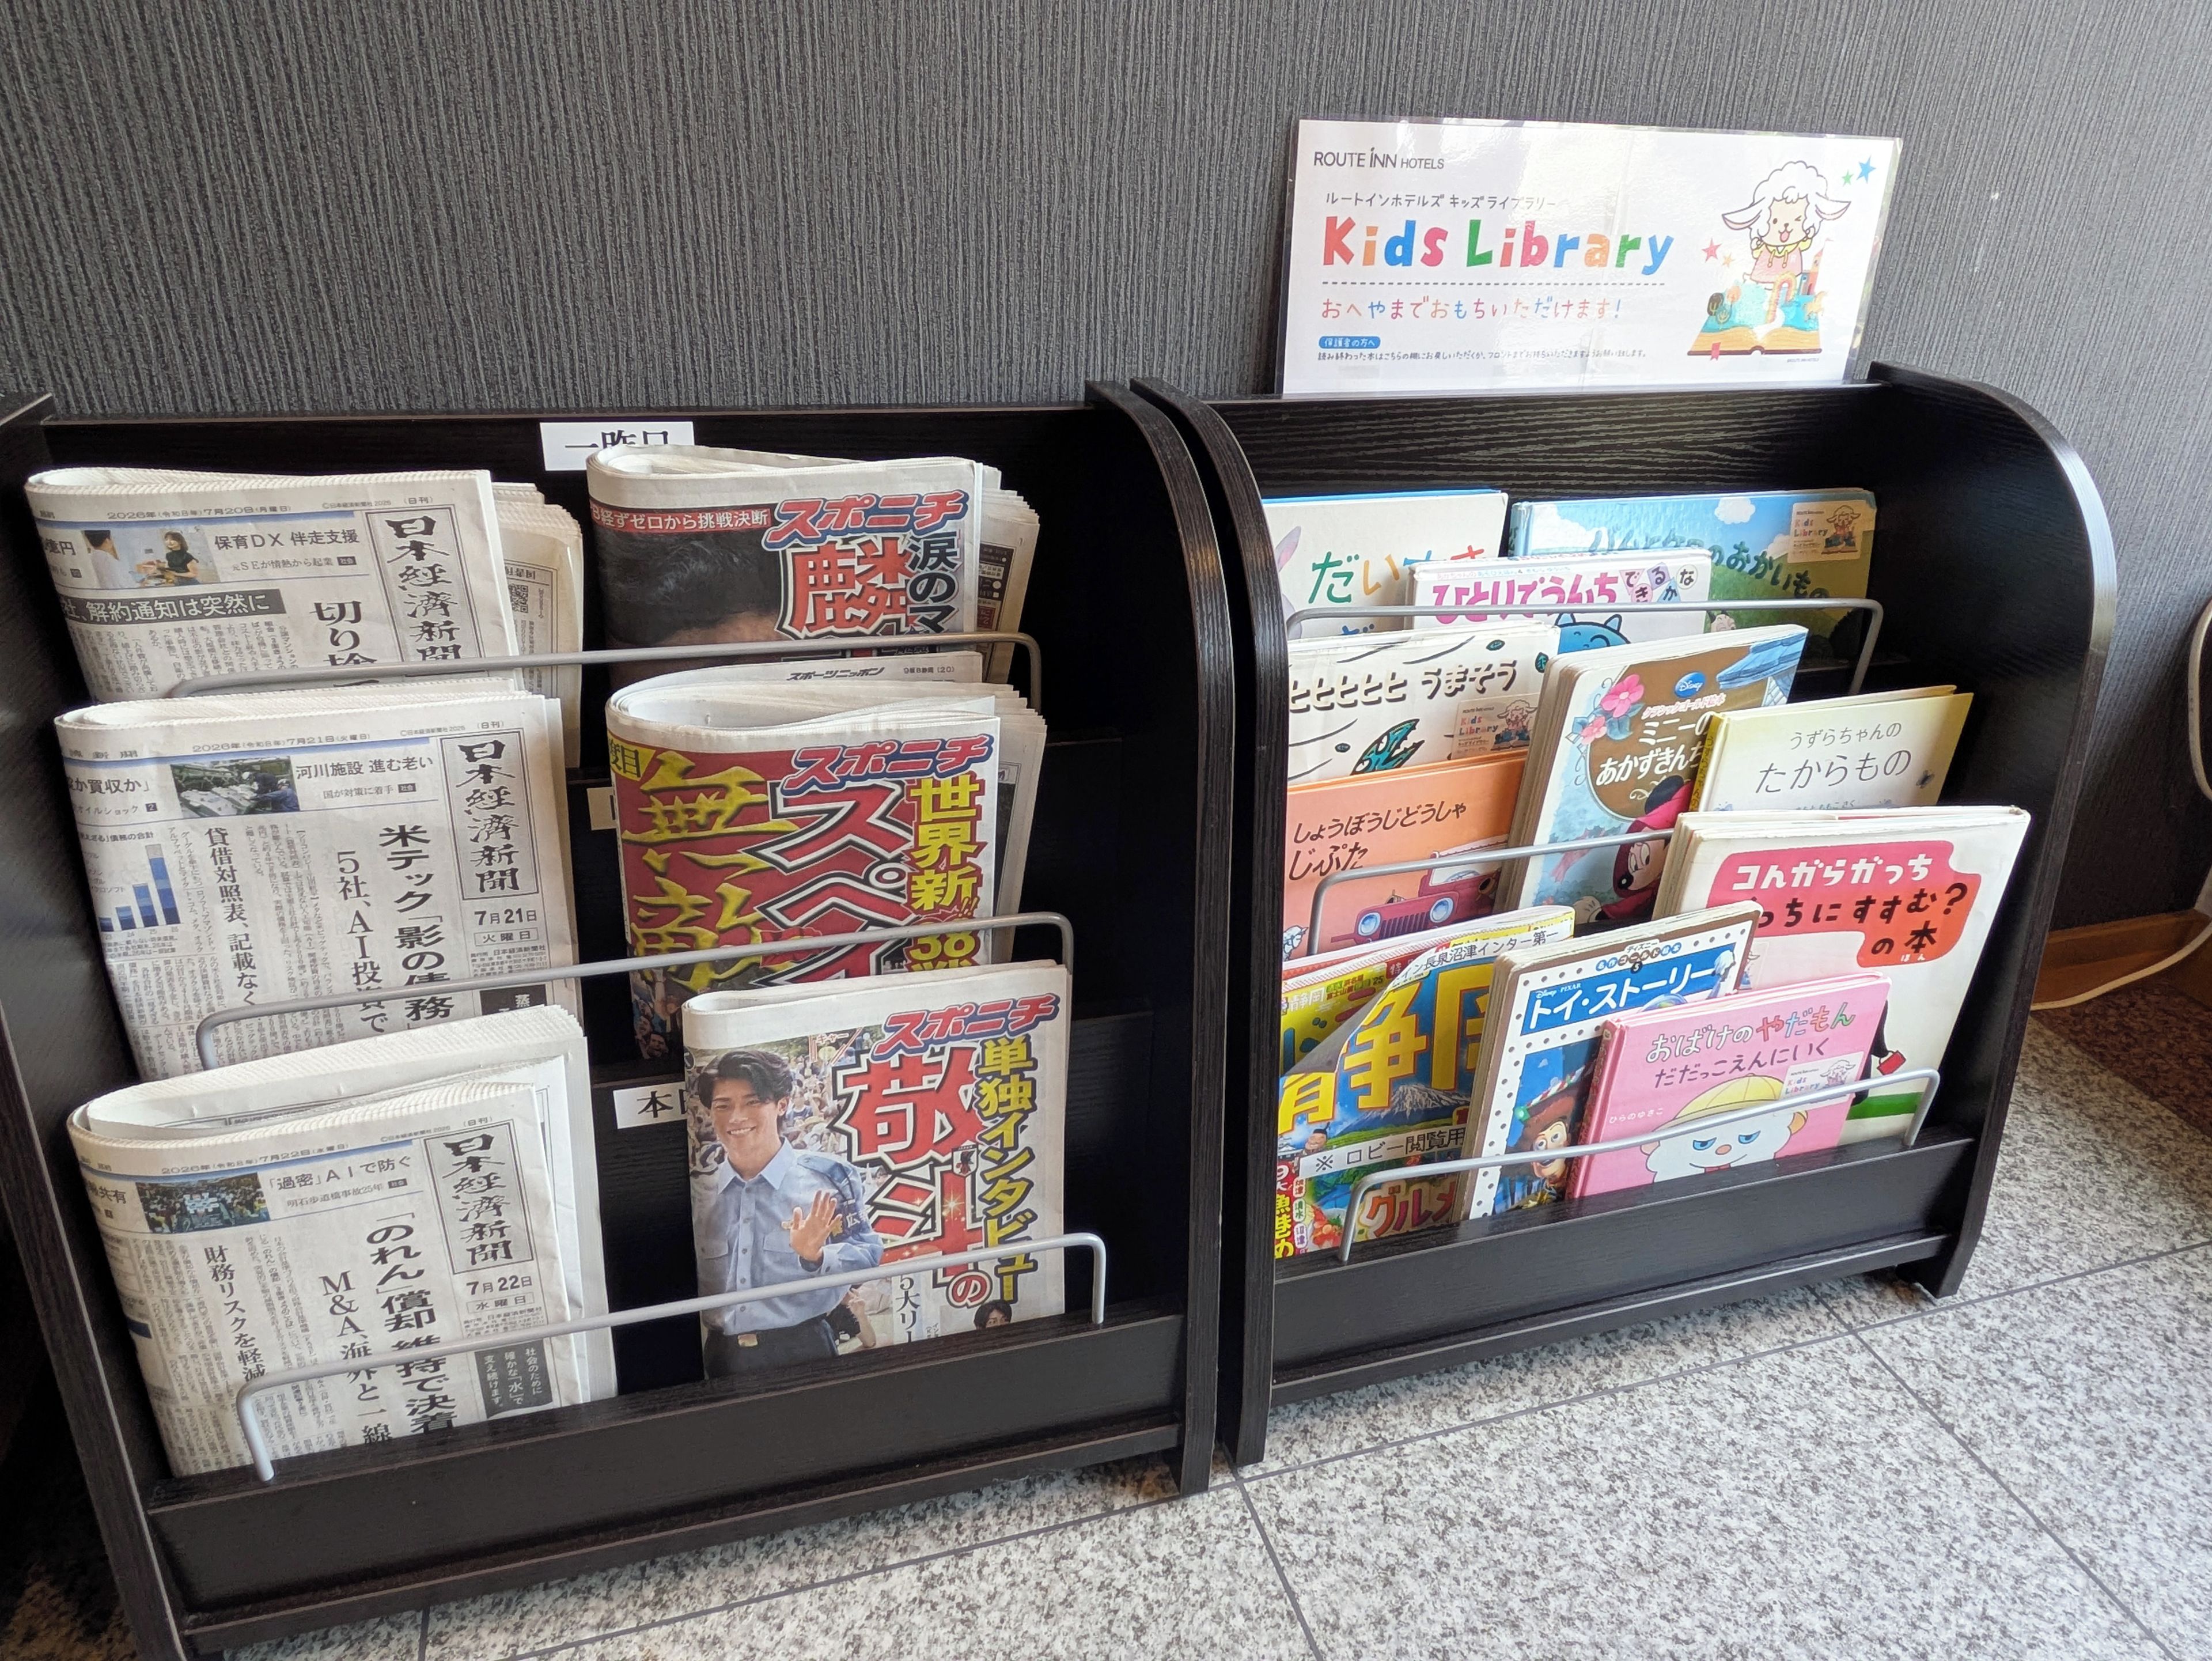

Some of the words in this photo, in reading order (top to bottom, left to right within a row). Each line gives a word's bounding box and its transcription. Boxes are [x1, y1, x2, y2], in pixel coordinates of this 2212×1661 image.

[1313, 152, 1365, 167] ROUTE
[1401, 158, 1444, 170] HOTELS
[1326, 192, 1444, 207] ルートインホテルズ
[1450, 194, 1484, 208] キッズ
[1488, 196, 1556, 210] ライブラリー
[1322, 215, 1449, 267] Kids
[1466, 219, 1674, 276] Library
[1321, 295, 1622, 319] おへやまでおもちいただけます!
[1324, 337, 1376, 348] 保護者の方へ
[403, 496, 434, 505] （日刊）
[765, 490, 966, 546] スポニチ
[214, 533, 285, 551] 保育DX
[290, 529, 360, 546] 伴走支援
[232, 557, 333, 571] 元SEが情熱から起業
[1308, 545, 1484, 604] だい
[908, 531, 959, 633] 涙のマ
[1433, 572, 1619, 625] ひとりでうんち
[786, 667, 885, 681] スポーツニッポン
[1422, 659, 1517, 699] うまそう
[1679, 680, 1703, 692] Disney
[477, 720, 505, 729] （日刊）
[1459, 725, 1499, 736] Library
[1638, 710, 1713, 746] ミニーの
[1790, 722, 1902, 751] うずらちゃんの
[296, 761, 365, 780] 河川施設
[369, 756, 434, 773] 進む老い
[782, 735, 993, 793] スポニチ
[1755, 749, 1911, 794] たからもの
[323, 784, 393, 800] 国が対策に着手
[1294, 801, 1467, 843] しょうぼうじどうしゃ
[1289, 842, 1369, 880] じぷた
[204, 827, 259, 1005] 貸借対照表、記載なく
[474, 907, 537, 926] 7月21日
[1757, 882, 1968, 928] っちにすすむ?
[483, 930, 531, 944] 火曜日
[1627, 942, 1658, 954] ディズニー
[1870, 920, 1938, 955] の本
[1529, 963, 1717, 1030] トイ・ストーリー
[1535, 988, 1557, 999] Disney
[1560, 983, 1582, 993] PIXAR
[873, 994, 1057, 1059] スポニチ
[1646, 1002, 1856, 1063] おばけのやだもん
[1655, 1038, 1830, 1088] だだっこえんにいく
[637, 1089, 687, 1118] 本
[1785, 1083, 1820, 1095] Library
[463, 1115, 493, 1127] （日刊）
[1609, 1107, 1664, 1124] ひらのゆきこ
[1346, 1127, 1466, 1164] ロビー閲覧用
[269, 1154, 411, 1191] 「過密」AIで防ぐ
[978, 1036, 1035, 1302] 単独インタビュー
[287, 1183, 382, 1208] 明石歩道橋事故25年
[1366, 1181, 1457, 1238] グルメ
[466, 1275, 532, 1295] 7月22日
[204, 1245, 267, 1382] 財務リスクを軽減
[476, 1295, 527, 1311] 水曜日
[484, 1355, 503, 1407] 支え続けます。
[504, 1351, 524, 1405] 確かな「水」で
[525, 1348, 543, 1395] 社会のために
